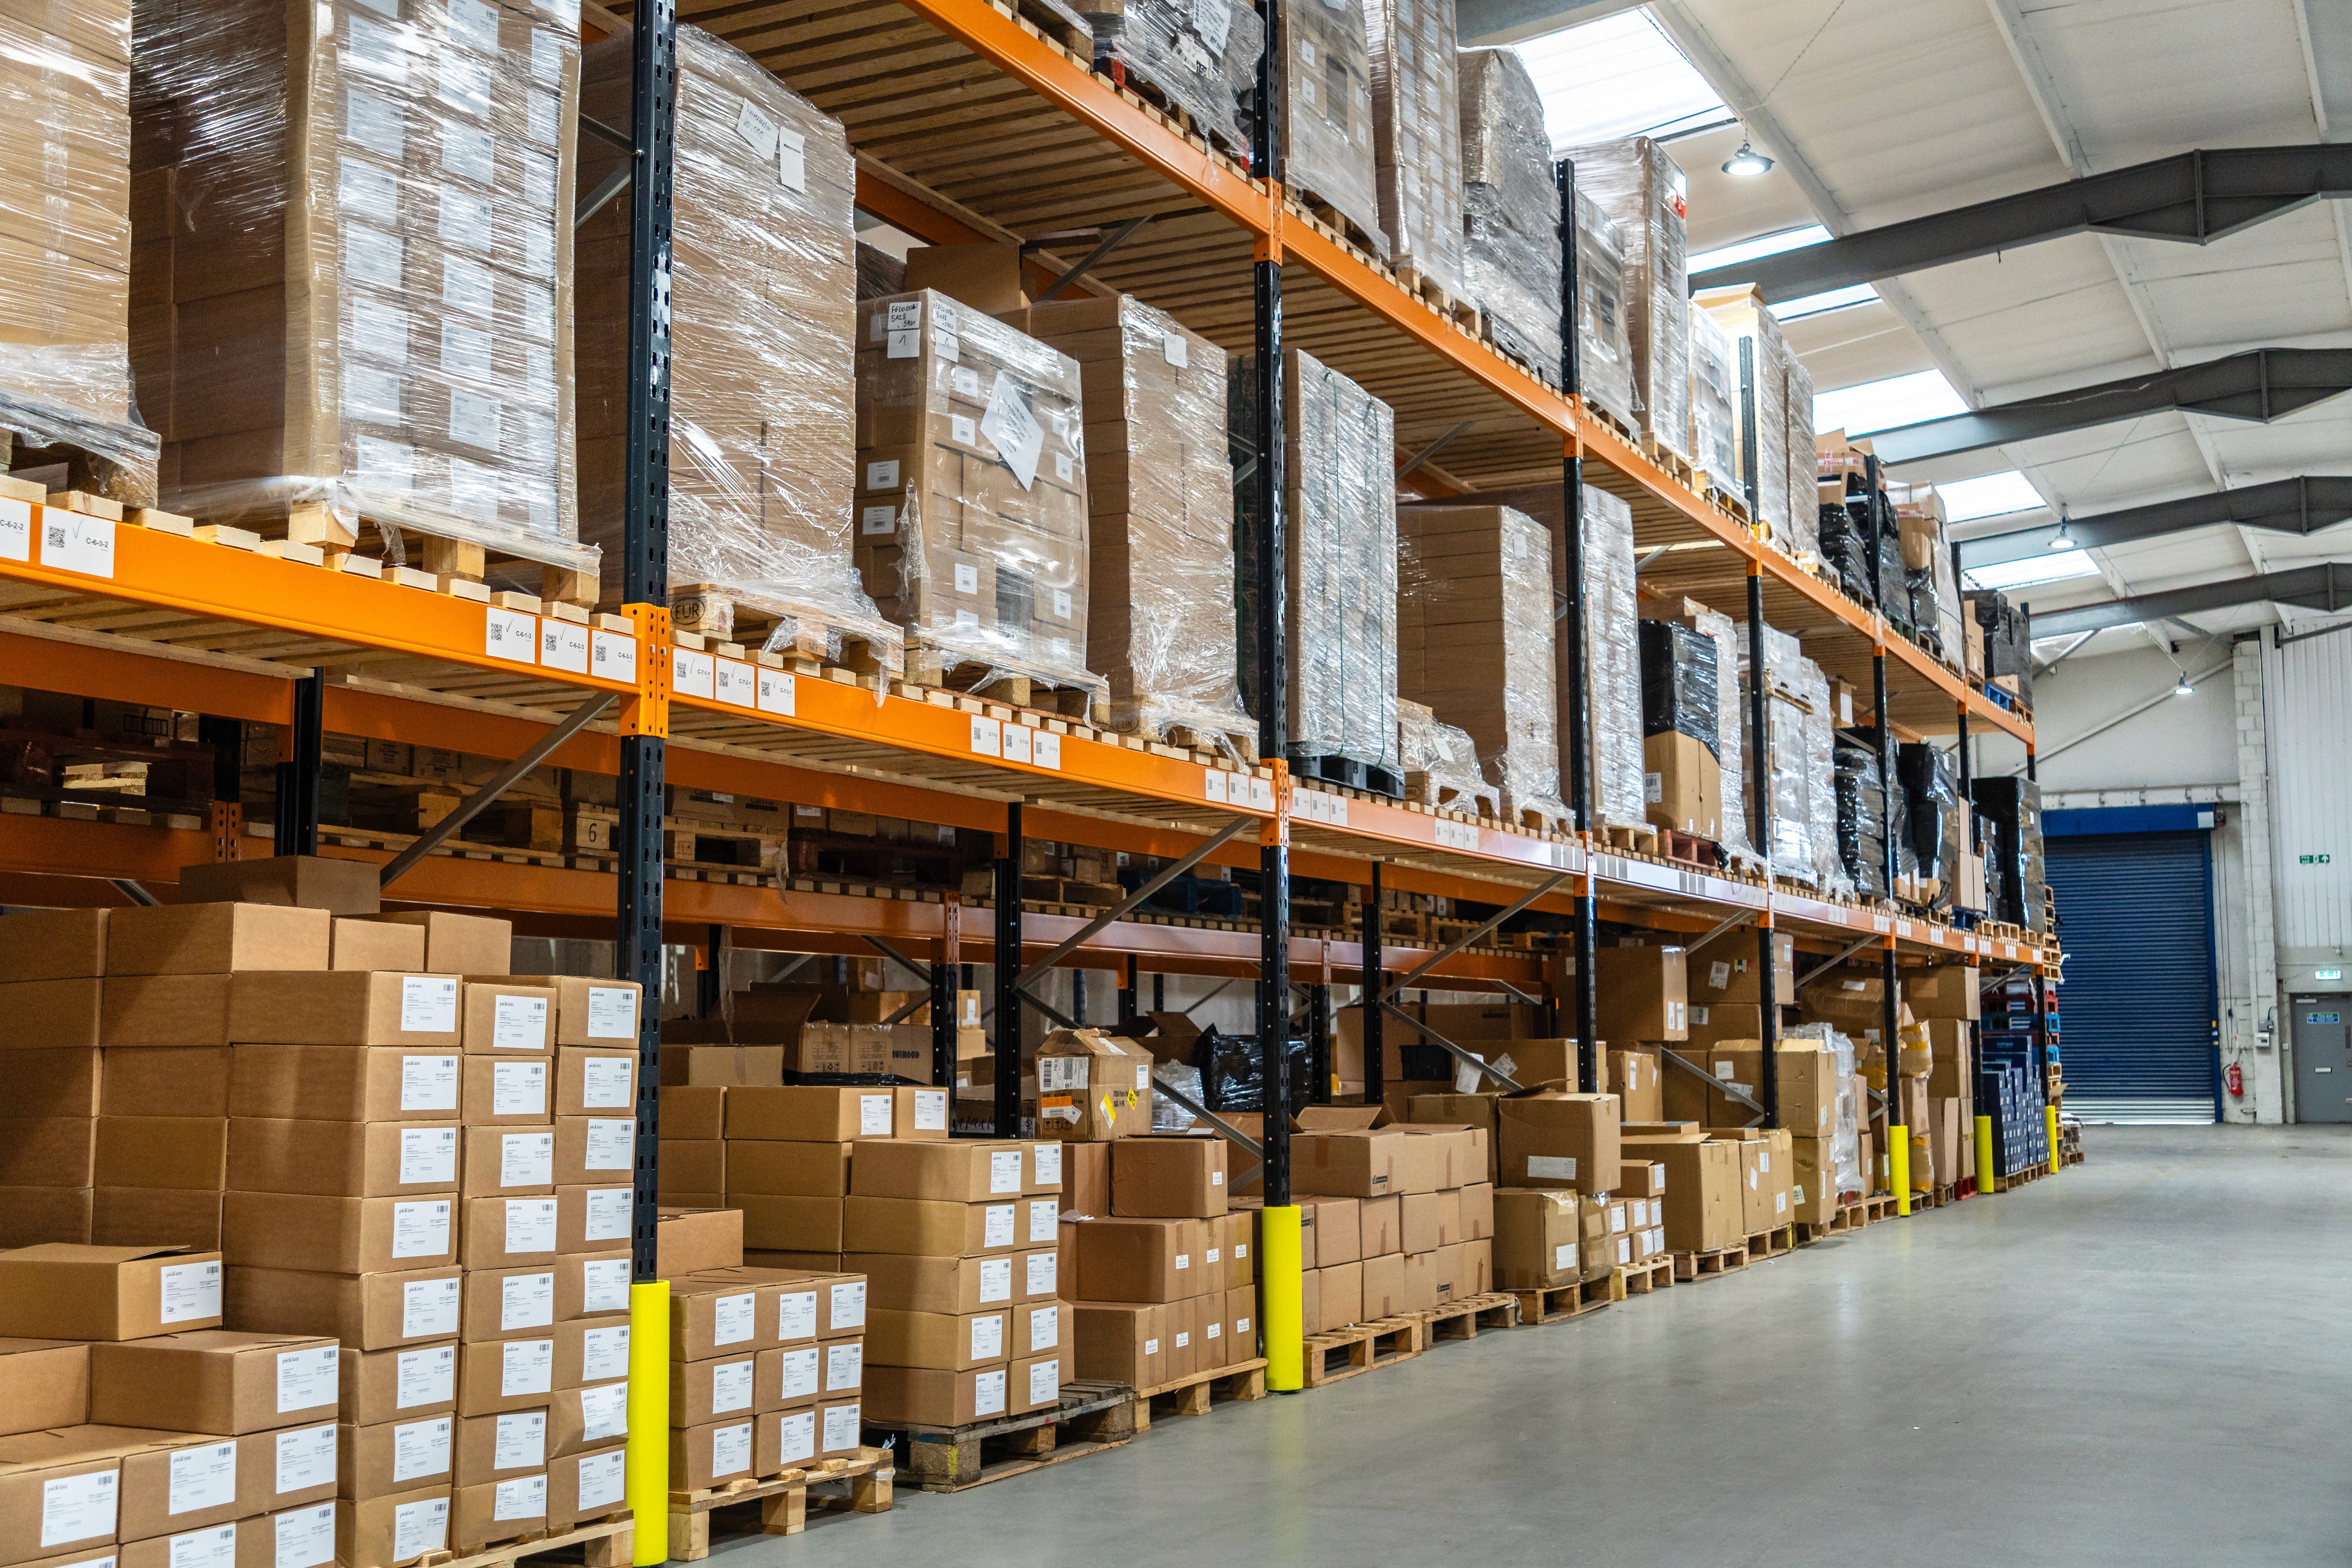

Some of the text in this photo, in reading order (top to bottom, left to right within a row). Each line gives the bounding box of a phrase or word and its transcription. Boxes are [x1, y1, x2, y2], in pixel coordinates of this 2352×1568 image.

[784, 143, 801, 154] Watermelon
[0, 520, 24, 530] C-6-2-2
[86, 538, 108, 548] C-6-3-2
[674, 603, 699, 618] EUR
[1405, 789, 1416, 797] PAL
[588, 823, 597, 842] 6
